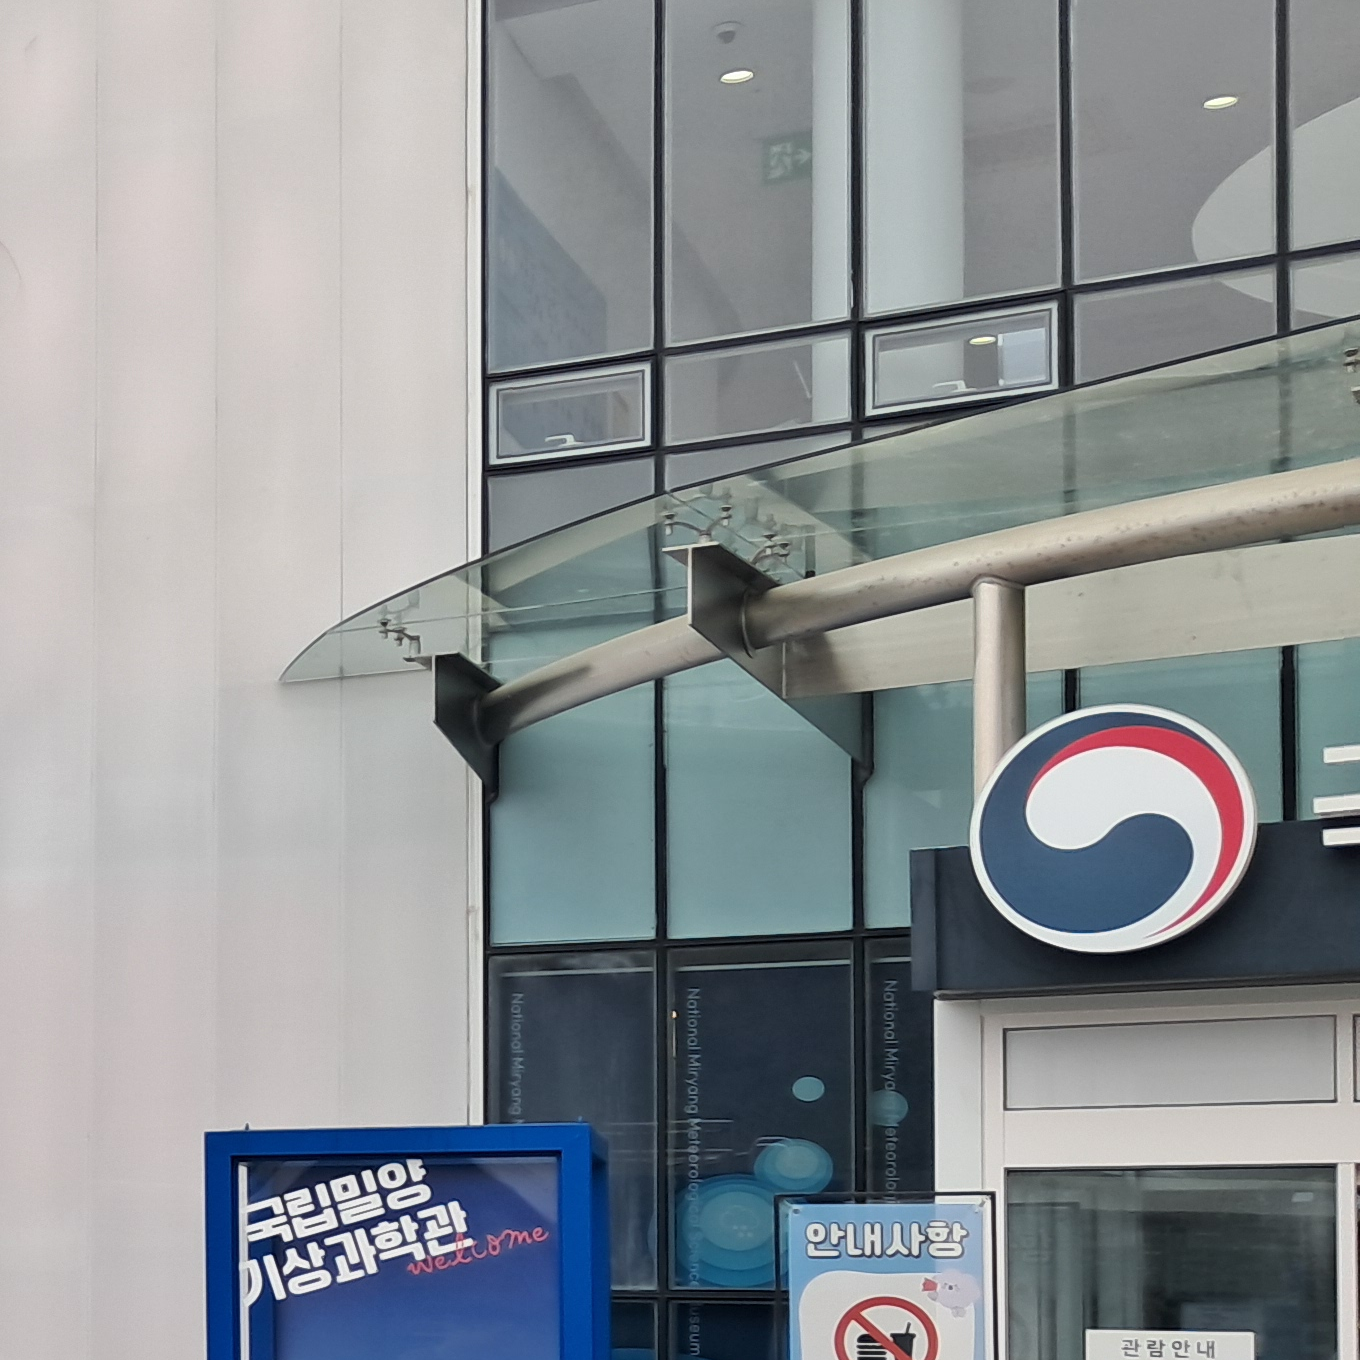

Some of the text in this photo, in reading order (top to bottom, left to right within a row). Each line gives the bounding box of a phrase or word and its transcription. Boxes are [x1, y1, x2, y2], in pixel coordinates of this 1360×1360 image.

[511, 993, 525, 1054] National
[686, 988, 702, 1051] National
[883, 980, 898, 1044] National
[508, 1056, 525, 1116] Miryang
[683, 1053, 702, 1114] Miryang
[246, 1158, 433, 1243] 국립밀양
[240, 1200, 474, 1306] 기상과학관
[407, 1224, 549, 1276] welcome
[804, 1221, 970, 1259] 안내사항
[687, 1301, 700, 1356] useum
[1121, 1339, 1217, 1359] 관람안내
